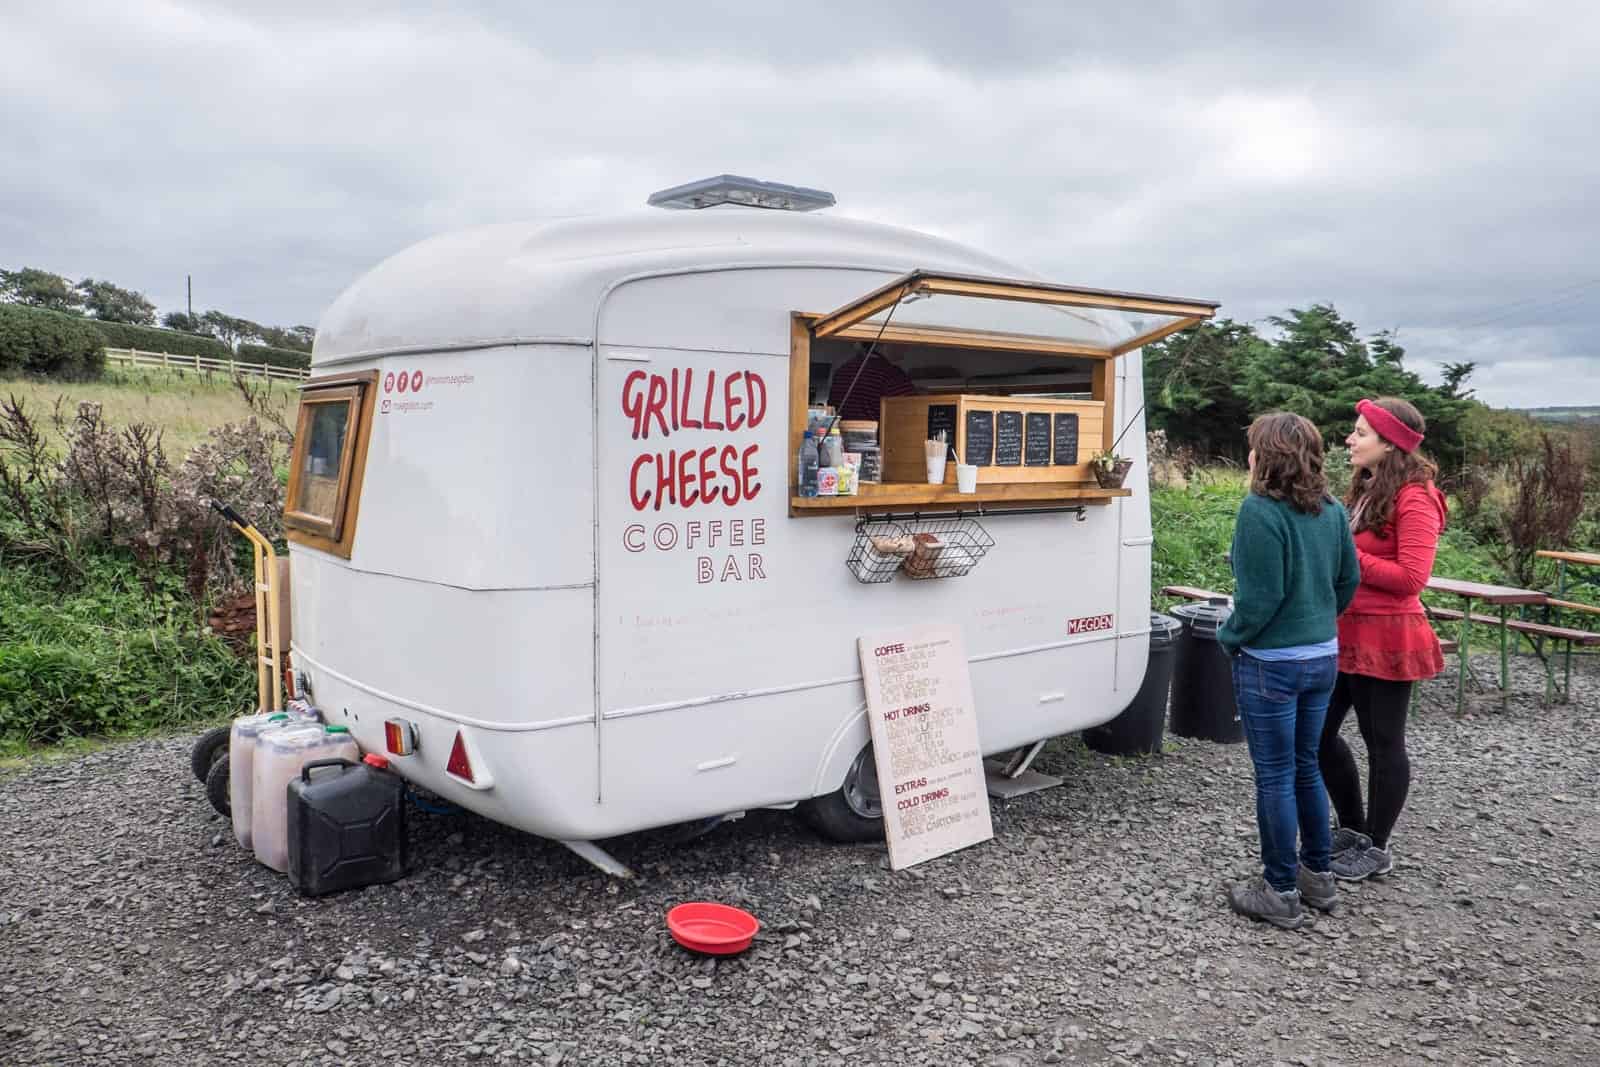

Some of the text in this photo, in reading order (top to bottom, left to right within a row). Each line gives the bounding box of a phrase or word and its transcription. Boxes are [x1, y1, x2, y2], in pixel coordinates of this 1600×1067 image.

[622, 367, 767, 440] GRILLED
[630, 444, 761, 511] CHEESE
[623, 518, 766, 553] COFFEE
[698, 553, 767, 584] BAR
[874, 643, 905, 657] COFFEE
[883, 710, 900, 721] HOT
[903, 702, 930, 718] DRINKS
[895, 777, 928, 795] EXTRAS
[897, 796, 920, 811] COLD
[921, 787, 950, 804] DRINKS
